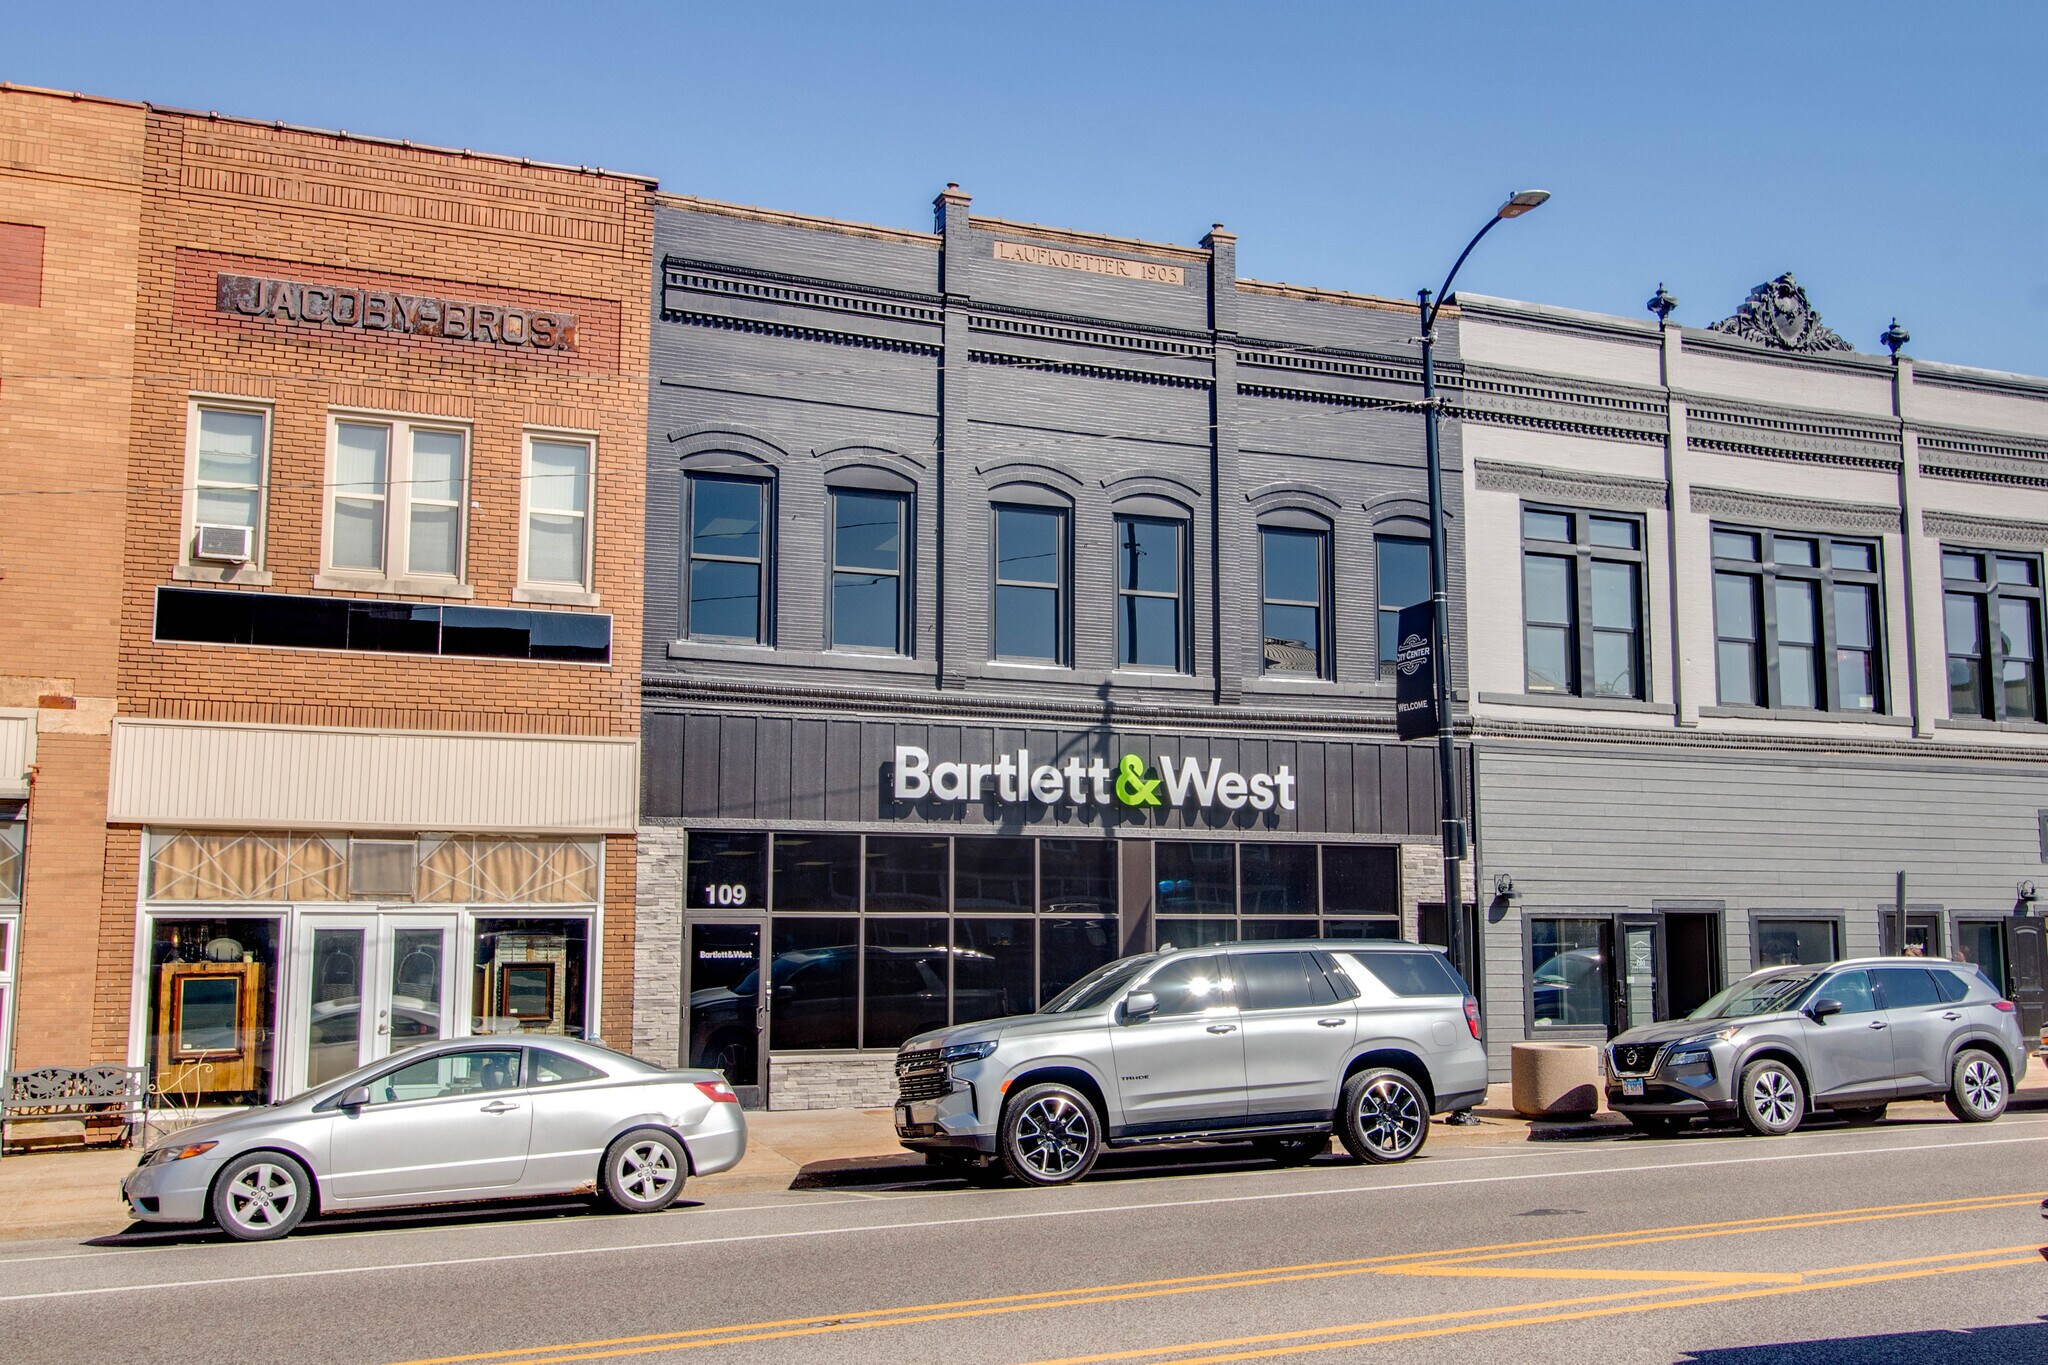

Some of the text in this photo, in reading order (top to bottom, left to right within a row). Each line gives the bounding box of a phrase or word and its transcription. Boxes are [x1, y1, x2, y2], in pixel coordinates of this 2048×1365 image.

[1406, 647, 1430, 660] CENTER
[1397, 700, 1428, 713] WELCOME
[894, 744, 1296, 811] Bartlett&West
[705, 884, 747, 905] 109
[699, 950, 753, 959] Bartlett&West
